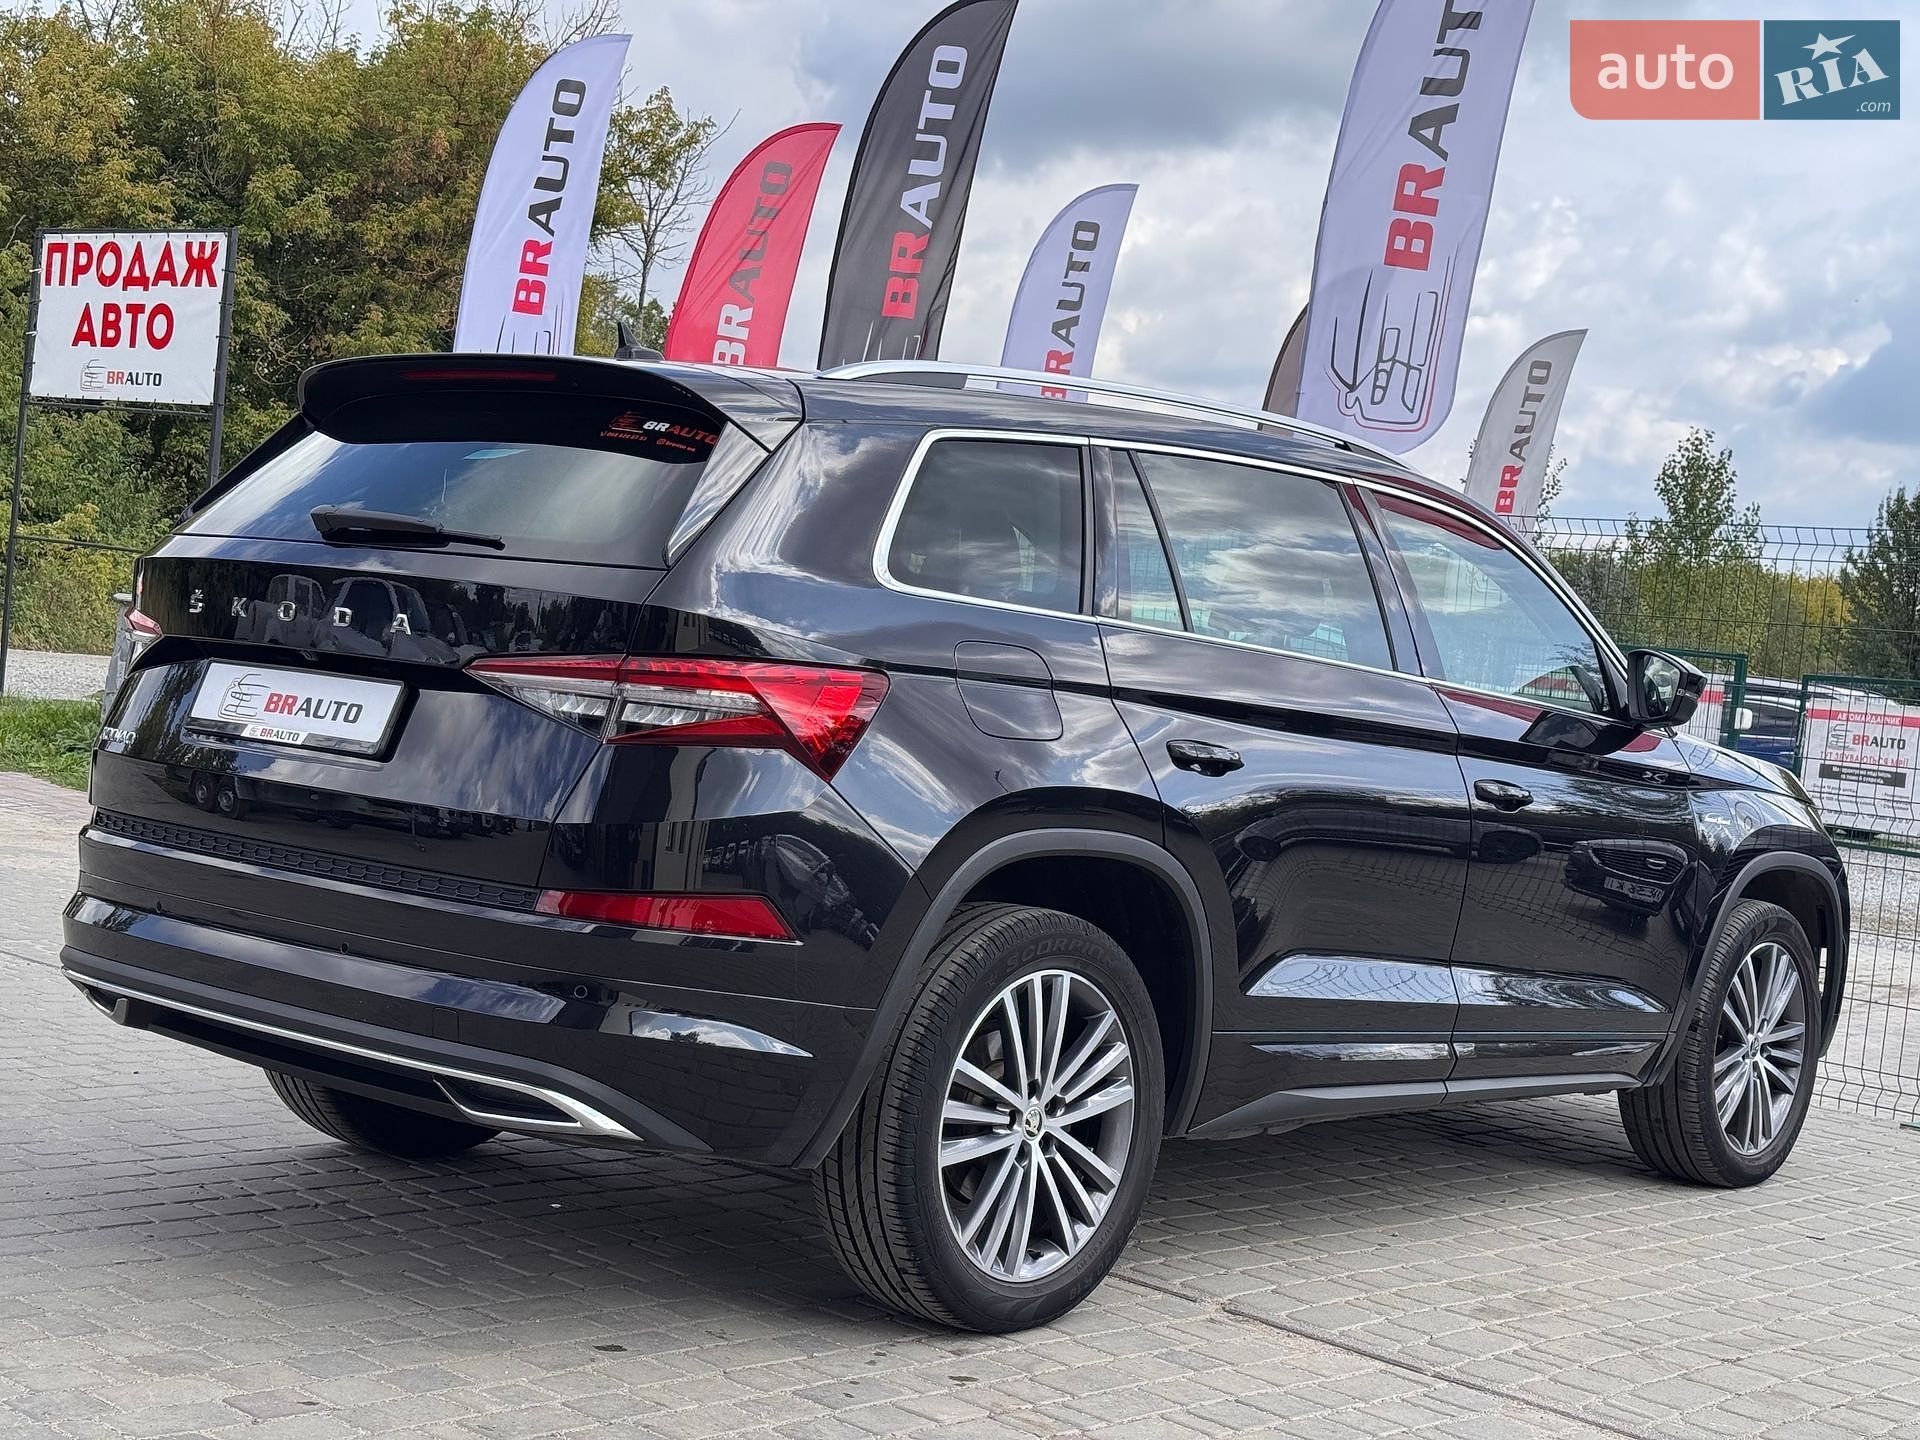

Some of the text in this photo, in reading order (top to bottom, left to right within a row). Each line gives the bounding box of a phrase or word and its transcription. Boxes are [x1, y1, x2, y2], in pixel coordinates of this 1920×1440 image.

[1384, 0, 1483, 272] BRAUT
[512, 78, 587, 316] BRAUTO
[881, 44, 968, 320] BRAUTO
[44, 240, 220, 292] ПРОДАЖ
[712, 161, 793, 366] BRAUTO
[72, 302, 175, 350] АВТО
[106, 370, 163, 387] BRAUTO
[642, 420, 719, 446] BRAUTO
[1495, 360, 1552, 514] BRAUTO
[264, 692, 364, 724] BRAUTO
[259, 727, 300, 742] BRAUTO
[1851, 733, 1906, 750] BRAUTO
